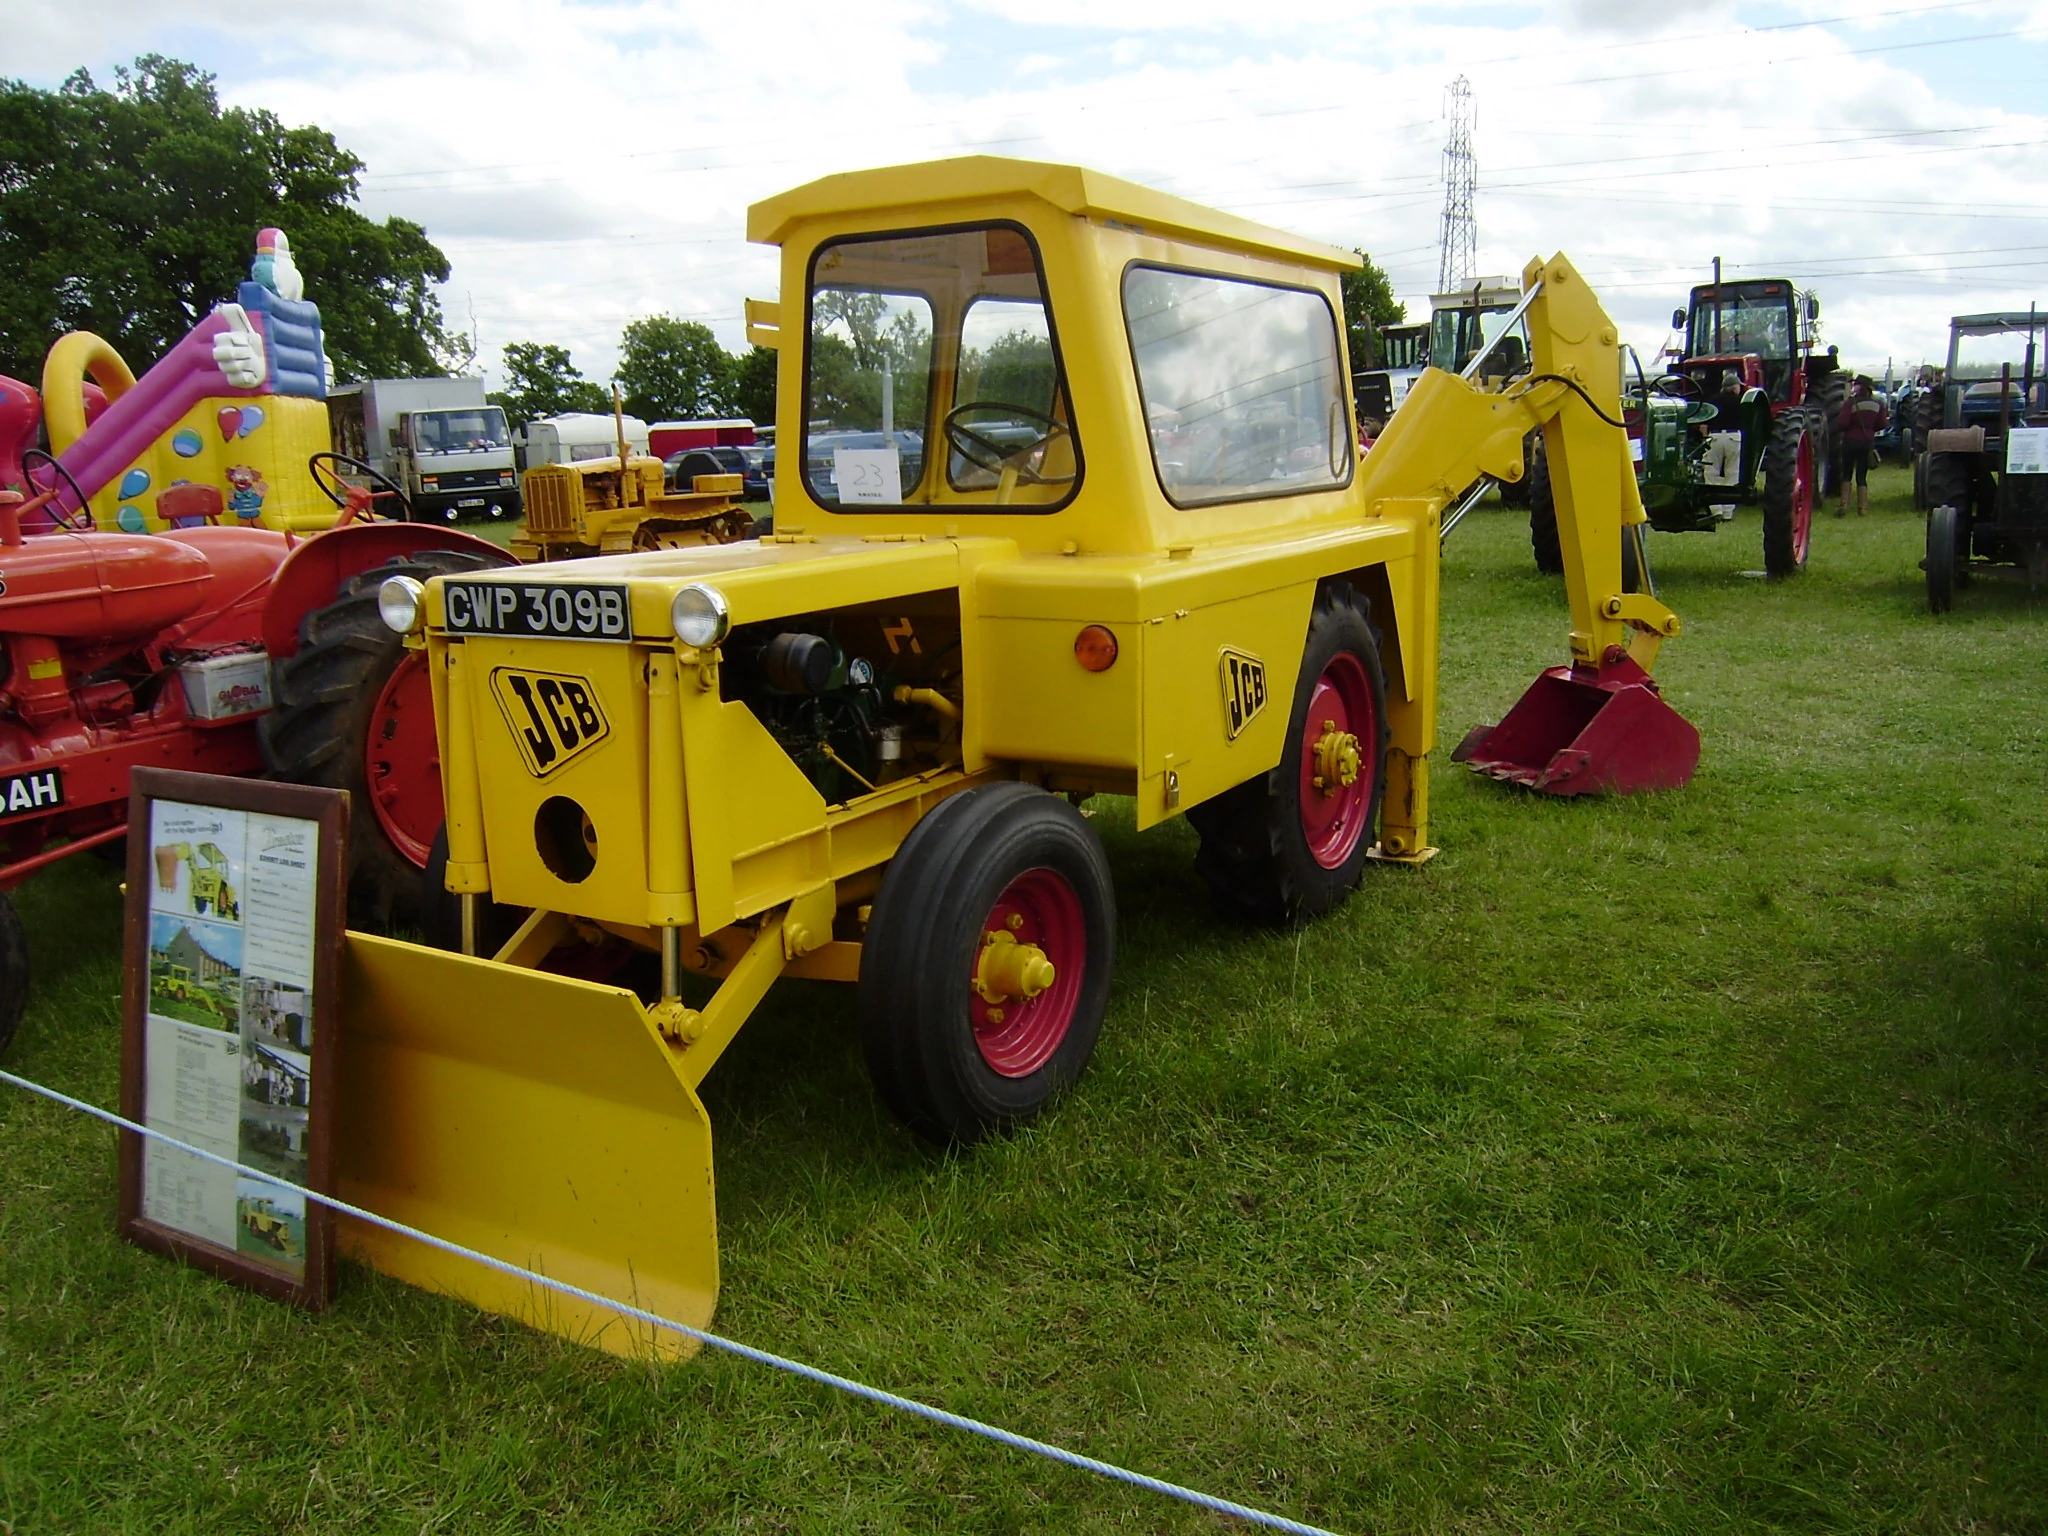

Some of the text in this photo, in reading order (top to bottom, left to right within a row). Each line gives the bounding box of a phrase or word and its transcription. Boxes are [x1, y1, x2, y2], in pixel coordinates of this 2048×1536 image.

[852, 463, 884, 488] 23
[448, 586, 625, 635] CWP 309B
[219, 684, 262, 701] GLOBAL
[1229, 657, 1264, 732] JCB
[507, 674, 601, 769] JCB
